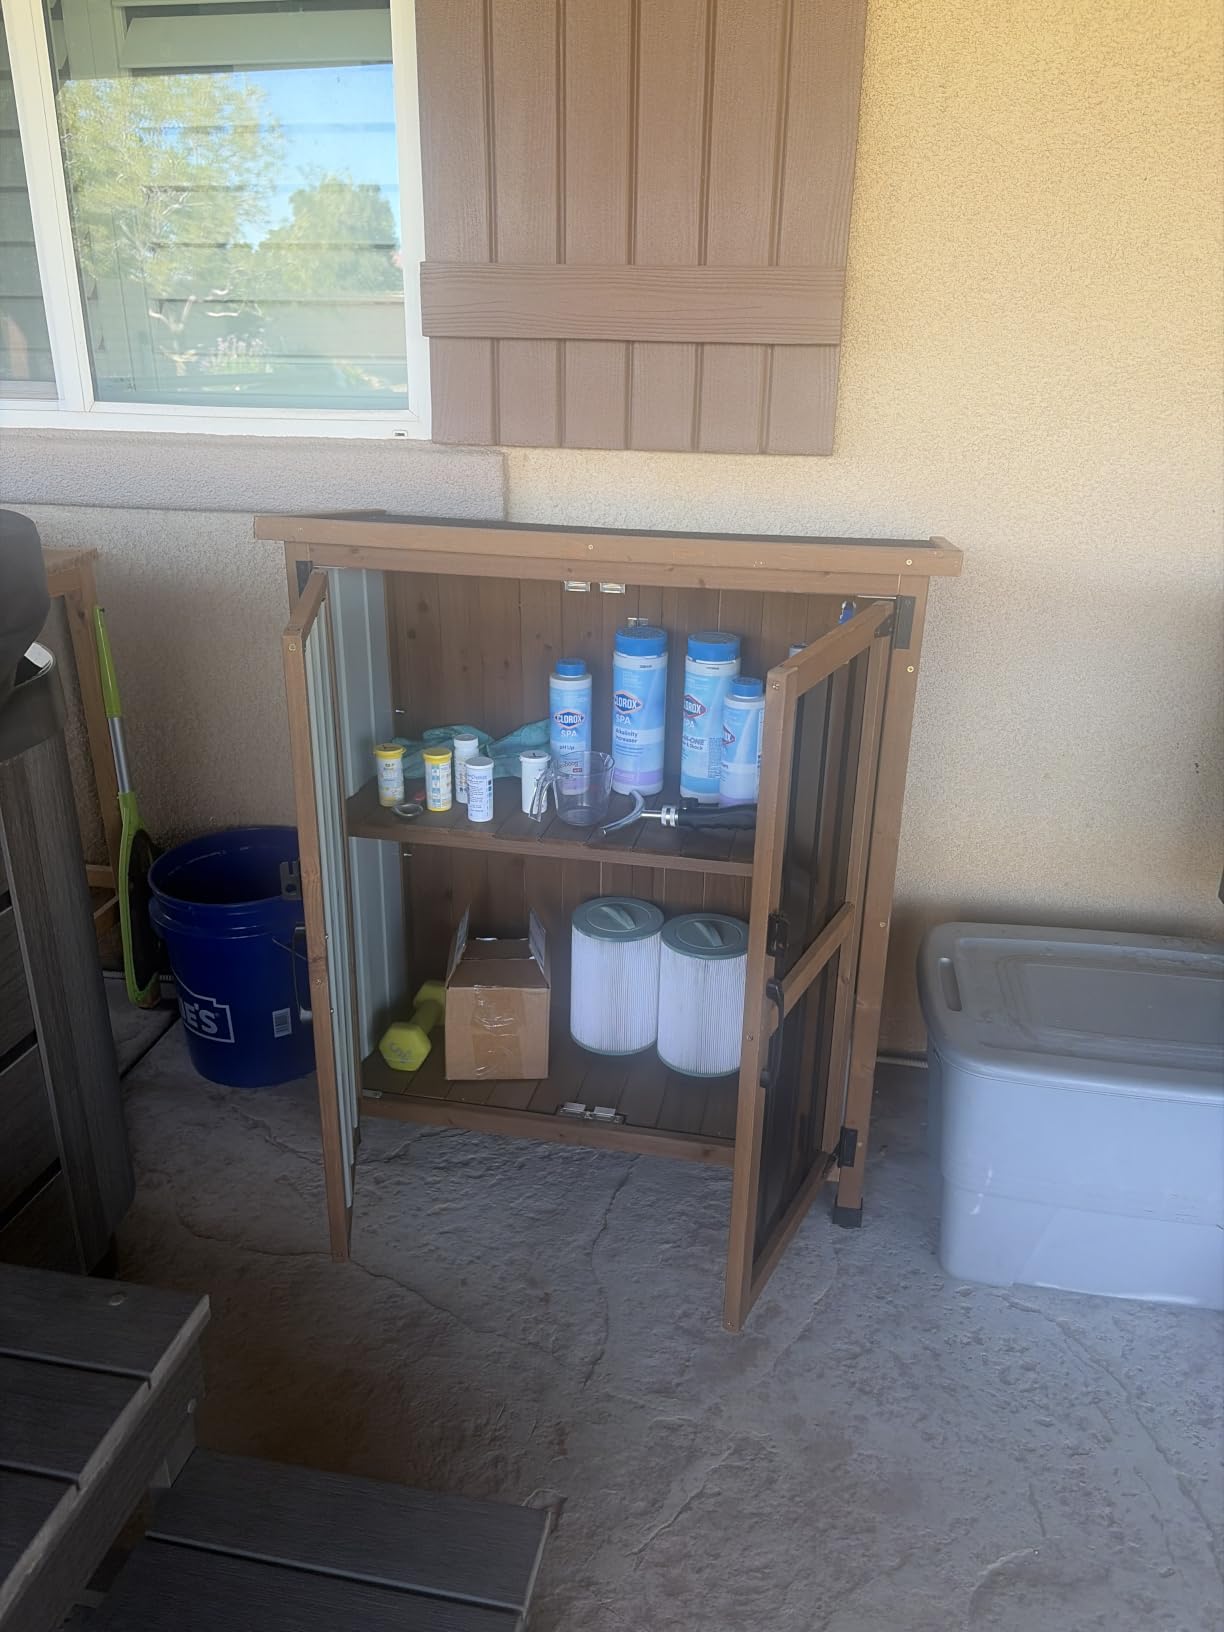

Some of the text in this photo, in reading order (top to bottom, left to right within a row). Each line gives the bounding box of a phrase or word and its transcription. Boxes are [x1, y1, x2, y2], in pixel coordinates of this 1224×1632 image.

[614, 696, 637, 709] CLOROX
[556, 714, 582, 724] CLOROX
[616, 714, 631, 725] SPA
[684, 720, 695, 728] PA
[183, 1000, 218, 1034] E'S
